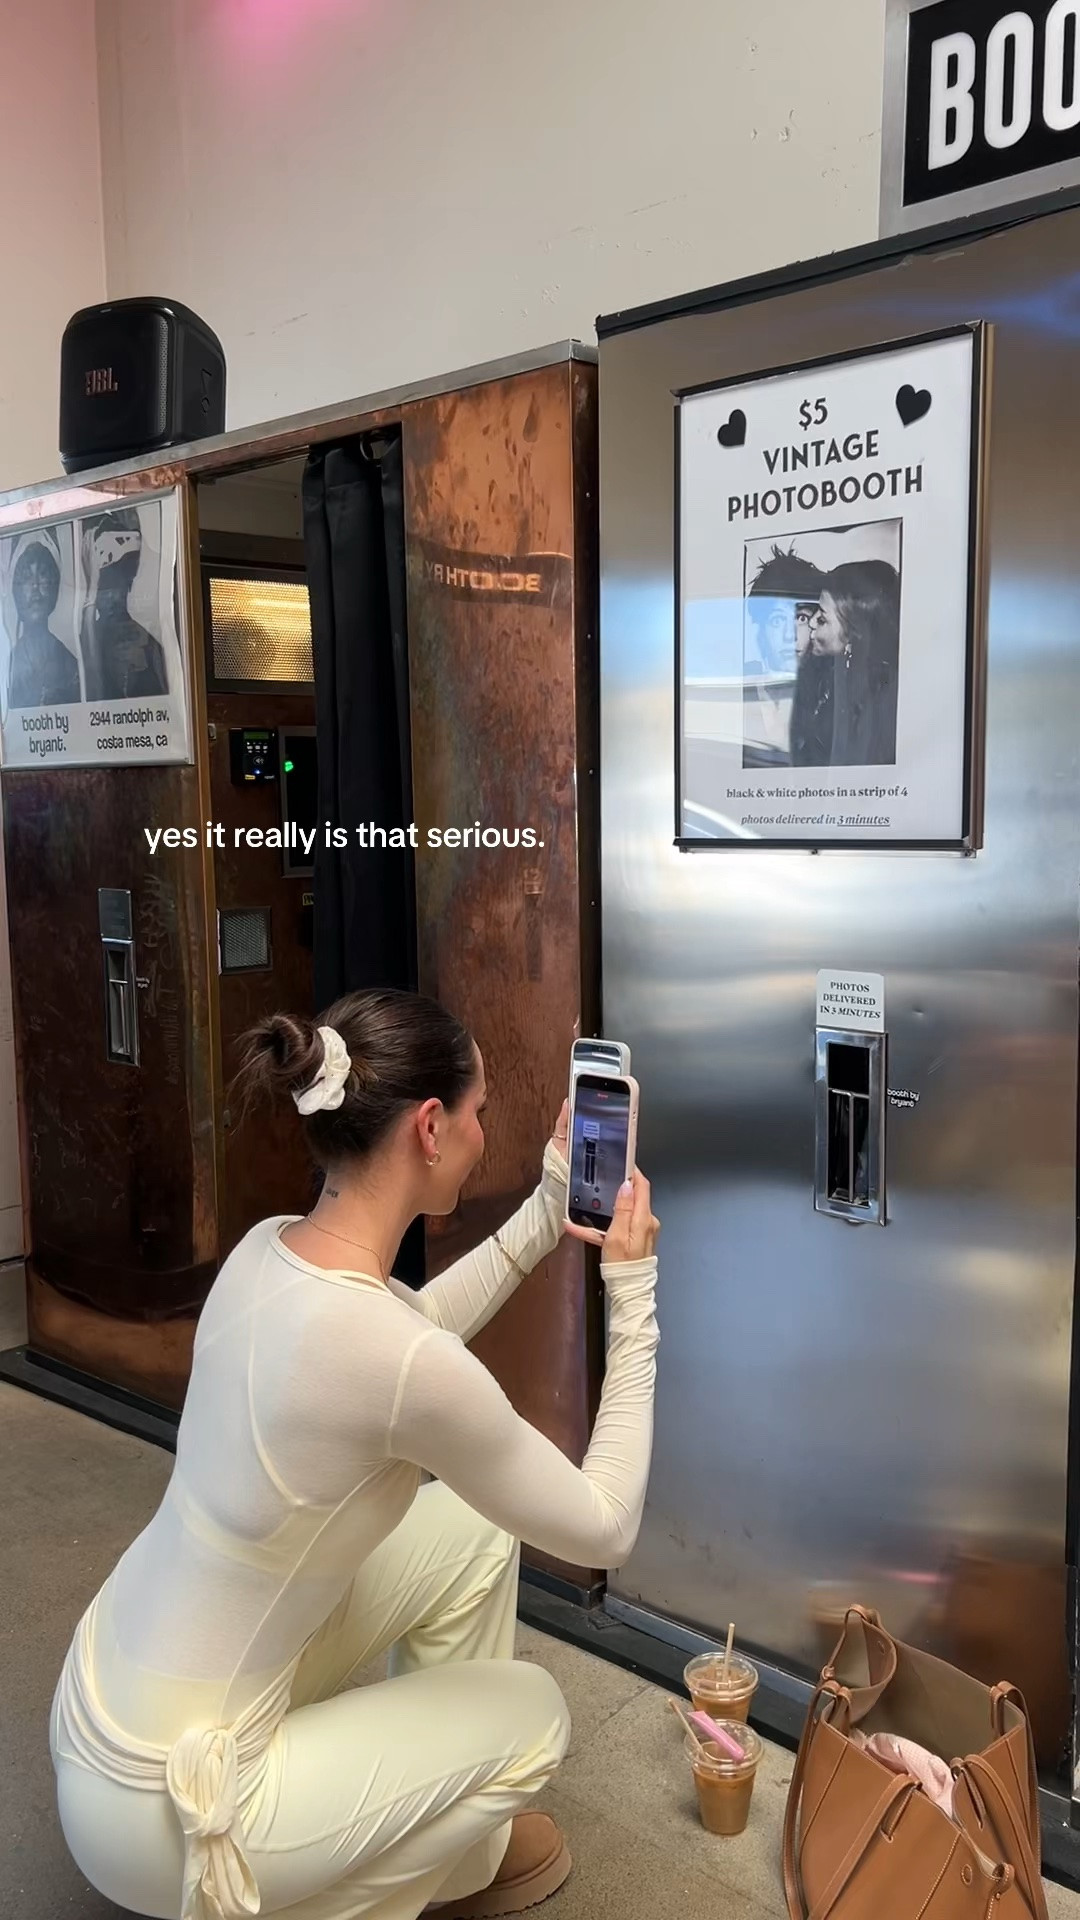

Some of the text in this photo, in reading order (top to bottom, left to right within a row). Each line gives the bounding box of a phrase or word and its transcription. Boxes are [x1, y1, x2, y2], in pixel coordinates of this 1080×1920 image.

[85, 367, 118, 396] JBL
[799, 397, 828, 430] $5
[763, 429, 879, 475] VINTAGE
[728, 465, 923, 522] PHOTOBOOTH
[21, 712, 69, 734] booth by
[89, 711, 111, 727] 2944
[112, 708, 154, 727] randolph
[29, 736, 67, 757] bryant.
[96, 734, 168, 750] costa mesa, ca
[726, 786, 909, 799] black & white photos in a strip of 4
[741, 814, 890, 826] photos delivered in 3 minutes
[830, 981, 870, 993] PHOTOS
[823, 993, 876, 1006] DELIVERED
[820, 1005, 881, 1019] IN 3 MINUTES
[887, 1088, 920, 1101] booth by
